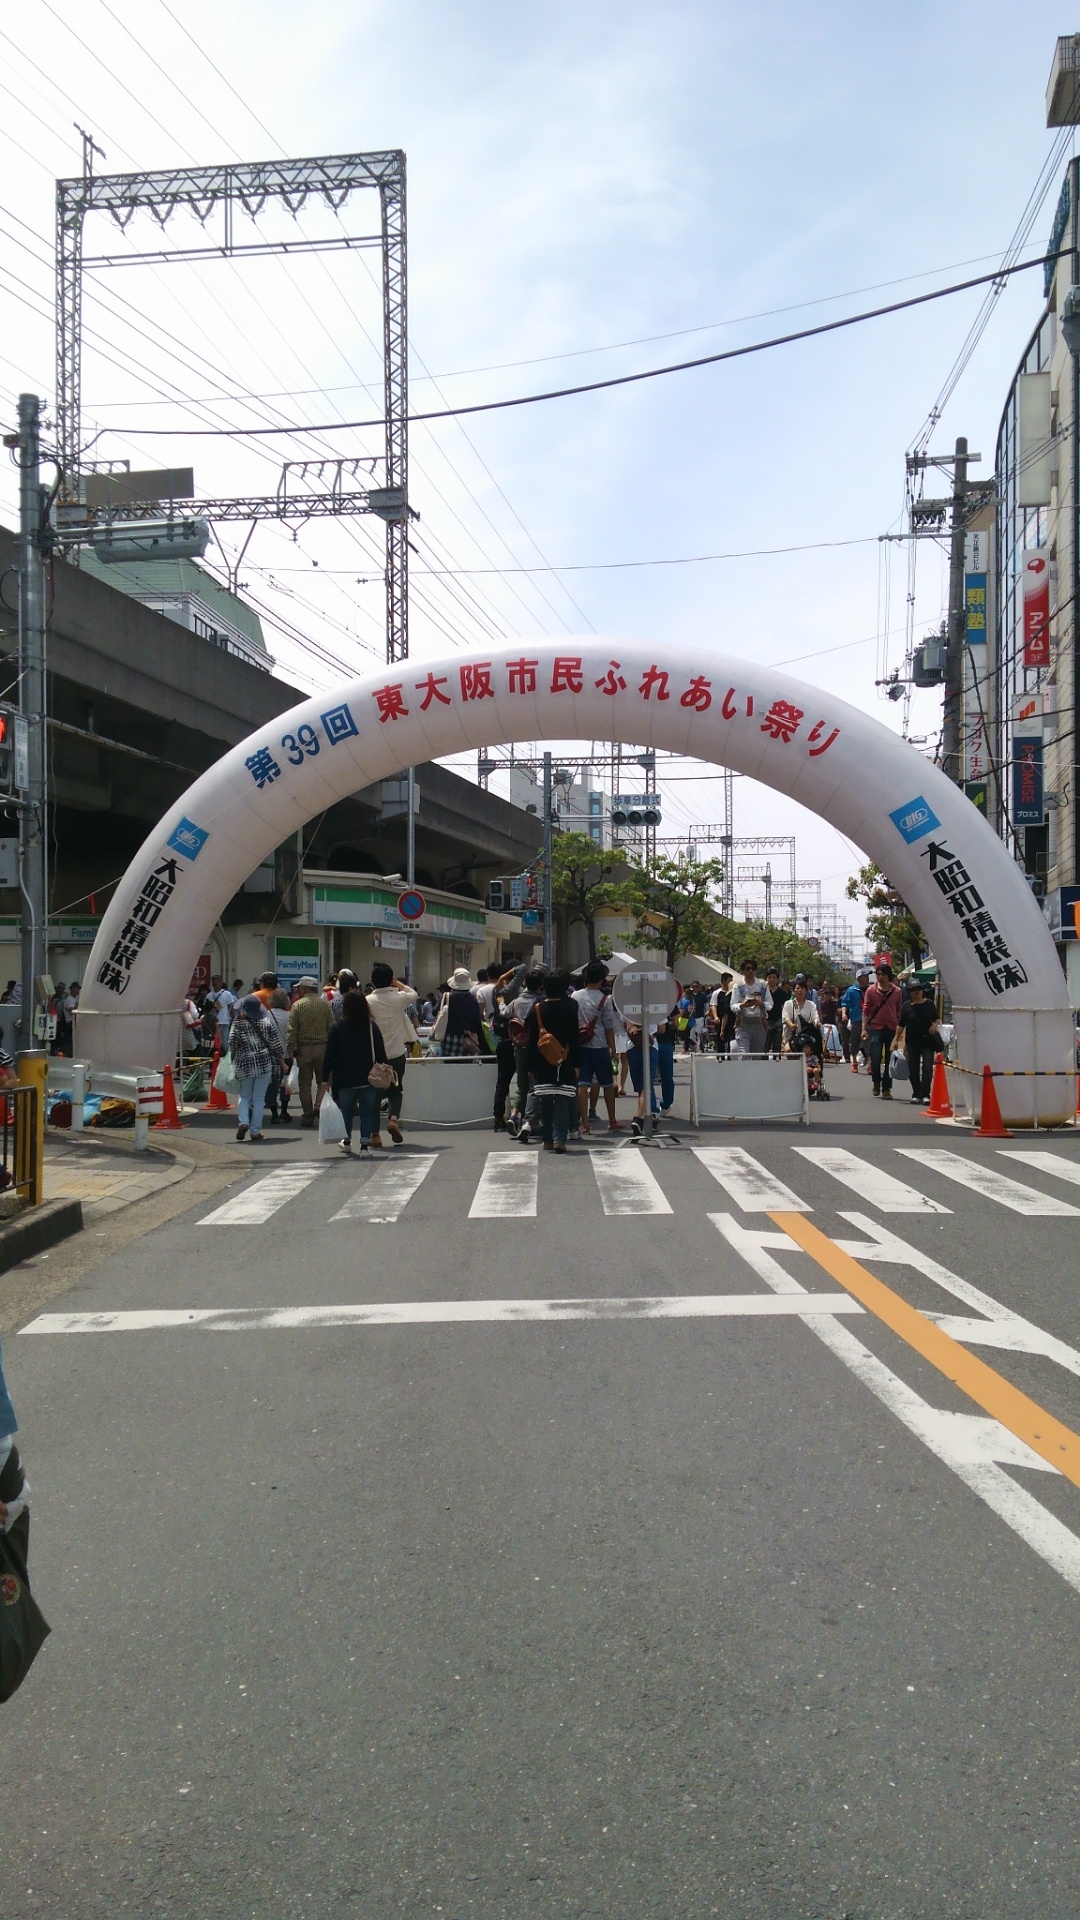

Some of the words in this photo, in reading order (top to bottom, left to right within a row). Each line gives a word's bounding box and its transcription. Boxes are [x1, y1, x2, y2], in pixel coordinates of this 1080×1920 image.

[1029, 611, 1044, 651] アコム
[1030, 653, 1043, 662] 3F
[244, 702, 360, 790] 第39回
[371, 656, 841, 757] 東大阪市民ふれあい祭り
[970, 715, 983, 782] フコク生命
[613, 795, 660, 806] 歩車分離式
[905, 810, 924, 826] BIG
[1017, 810, 1040, 819] プロミス
[71, 927, 98, 938] Famil
[278, 960, 318, 970] FamilyMart
